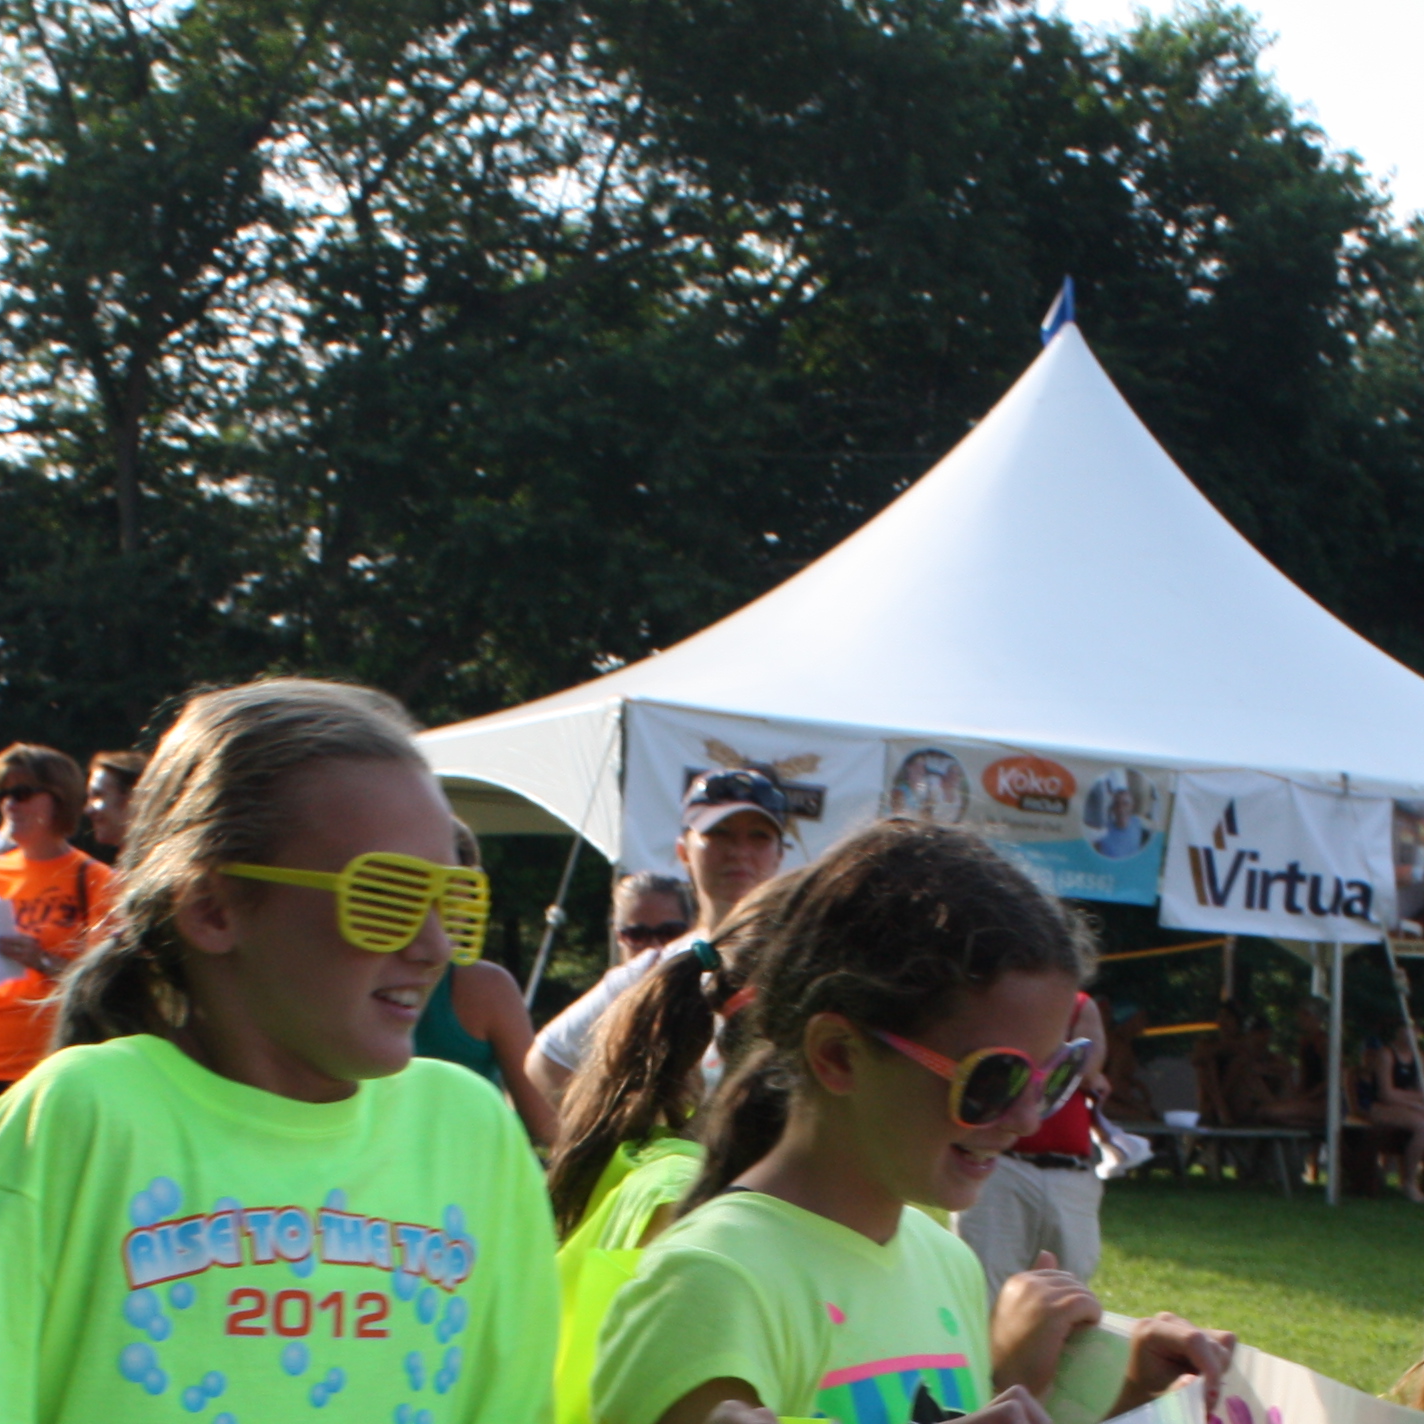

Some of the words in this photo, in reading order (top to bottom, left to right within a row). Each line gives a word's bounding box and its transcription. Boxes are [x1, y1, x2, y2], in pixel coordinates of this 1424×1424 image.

[1187, 846, 1373, 921] Virtua
[121, 1208, 243, 1291] RISE
[244, 1205, 314, 1267] TO
[314, 1206, 394, 1271] THE
[224, 1286, 391, 1339] 2012
